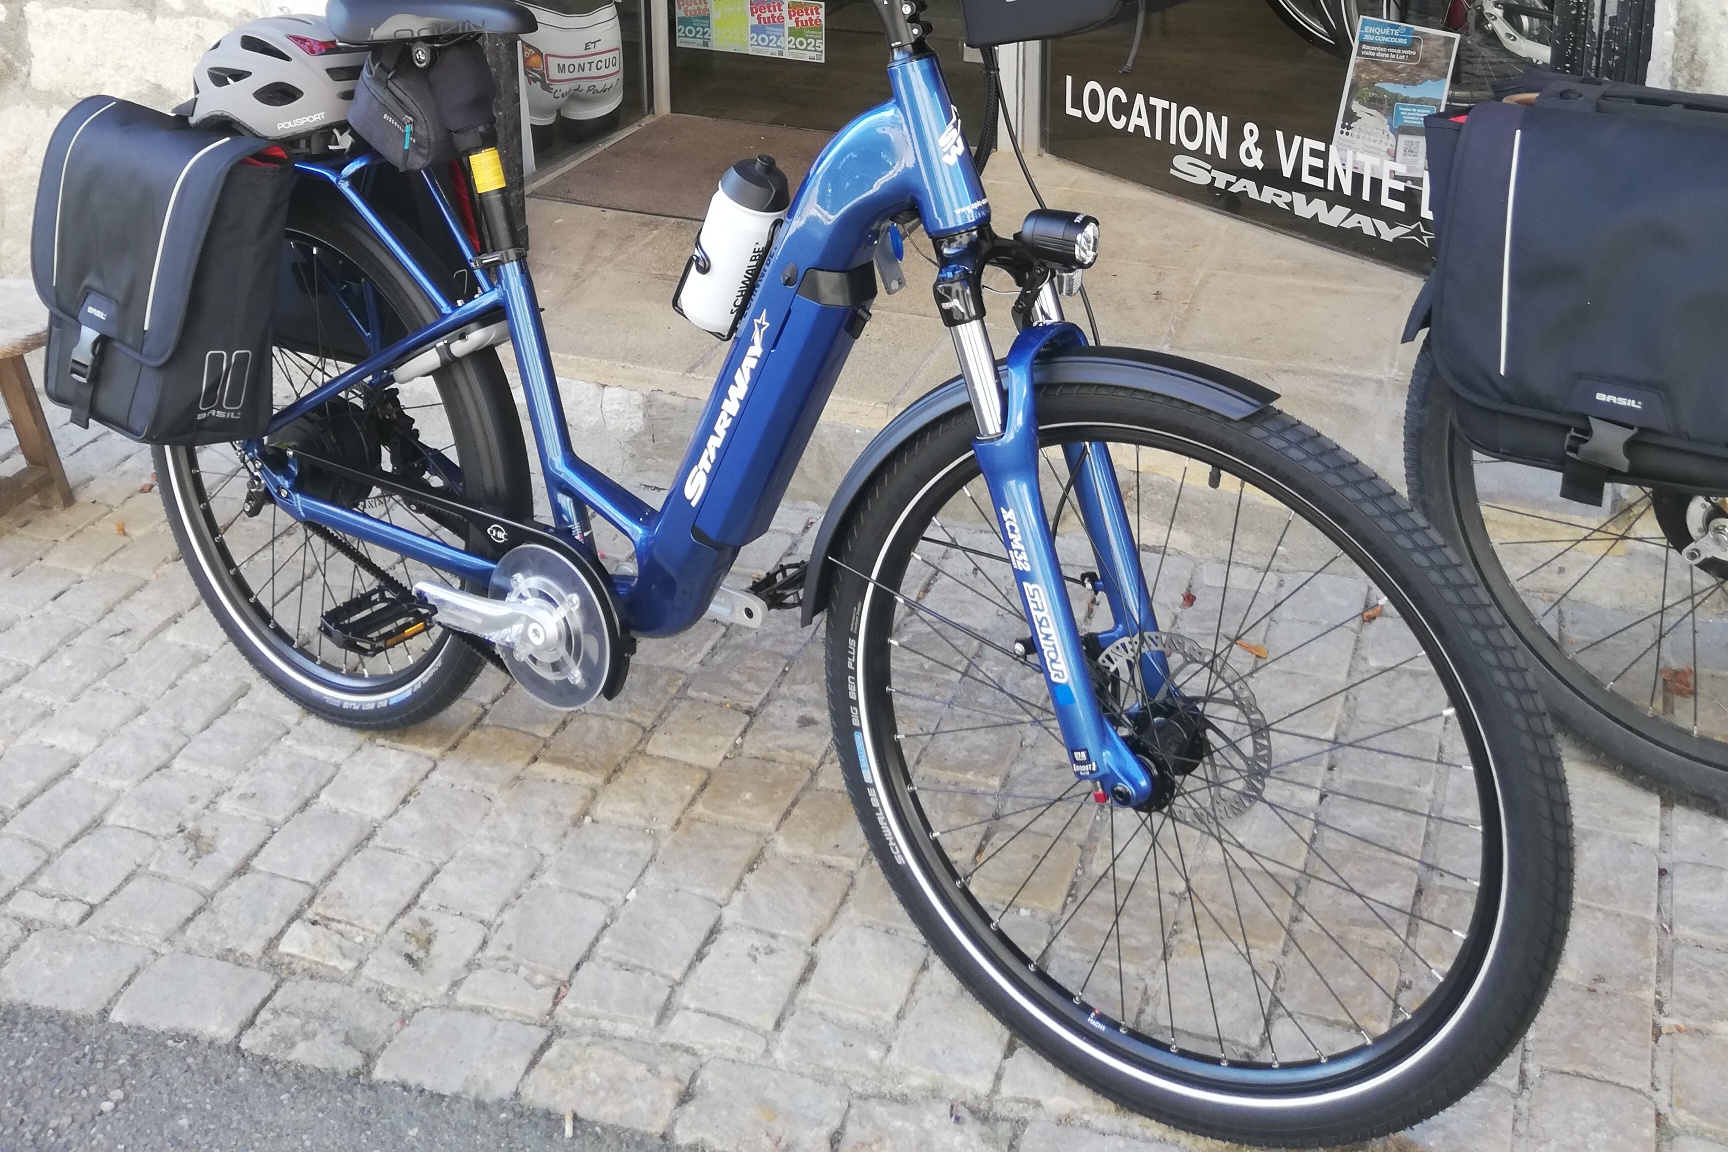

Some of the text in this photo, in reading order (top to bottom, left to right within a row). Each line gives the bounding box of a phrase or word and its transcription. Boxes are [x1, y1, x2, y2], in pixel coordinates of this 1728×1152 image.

[684, 5, 710, 17] futé
[750, 2, 782, 17] petit
[788, 5, 820, 19] petit
[757, 12, 785, 25] futé
[795, 16, 822, 28] futé
[678, 26, 711, 38] 2022
[750, 33, 785, 47] 2024
[1375, 35, 1407, 44] CONCOURS
[584, 39, 601, 50] ET
[788, 37, 823, 51] 2025
[557, 56, 616, 73] MONTCUQ
[277, 111, 326, 130] POLISPORT
[1066, 75, 1228, 160] LOCATION
[1240, 122, 1264, 170] &
[1276, 130, 1406, 212] VENTE
[1170, 154, 1411, 242] STARWAY
[730, 246, 765, 315] SCHWALBE
[1595, 392, 1642, 409] BASIL
[197, 410, 239, 420] BASIL
[684, 332, 764, 508] STARWAY
[1001, 507, 1030, 572] XCM32
[847, 638, 856, 670] PLUS
[1035, 614, 1065, 681] SUNTOUR
[852, 705, 860, 727] BIG
[866, 787, 906, 865] SCHWALBE
